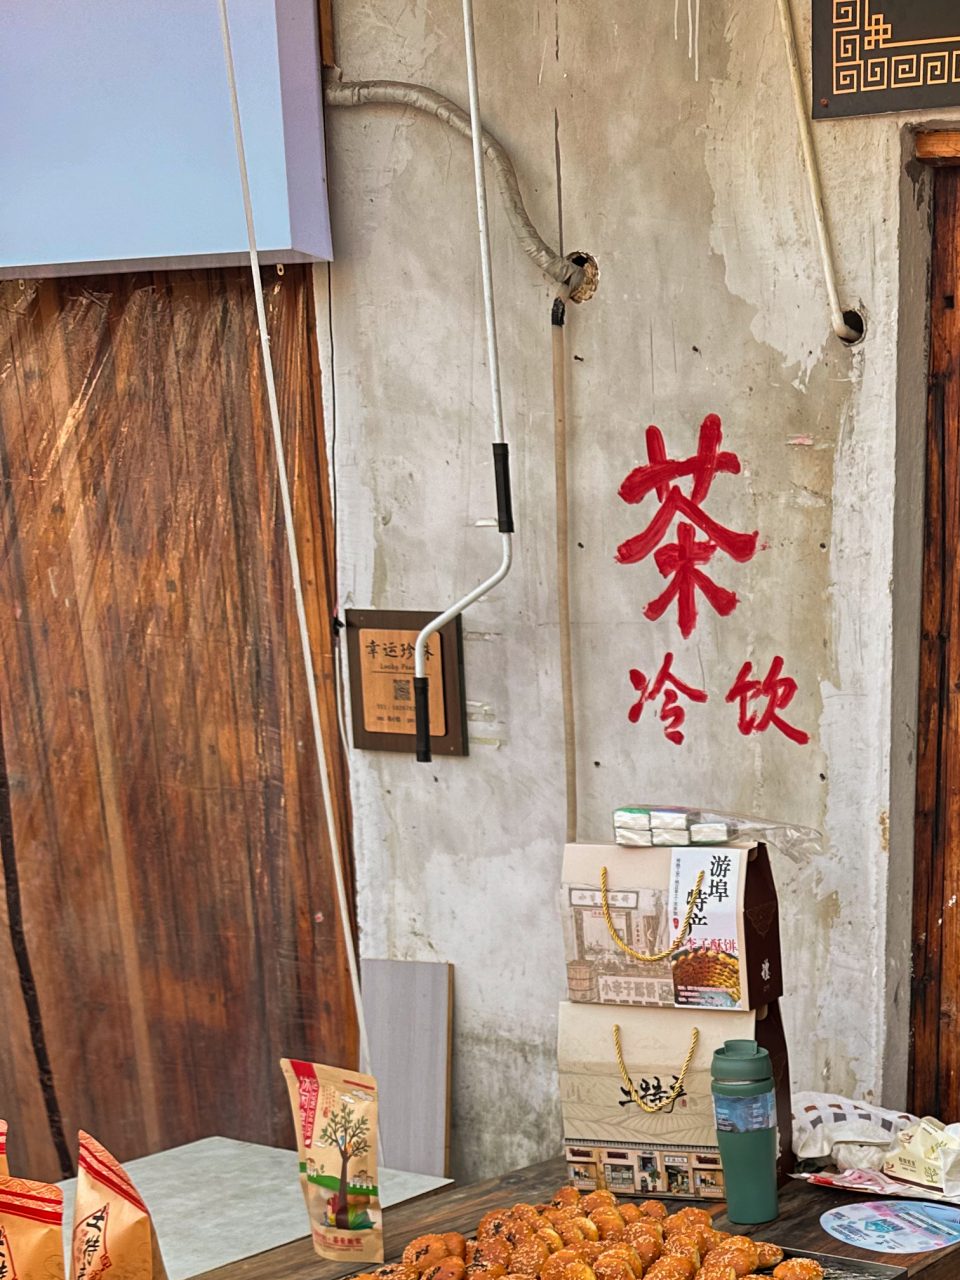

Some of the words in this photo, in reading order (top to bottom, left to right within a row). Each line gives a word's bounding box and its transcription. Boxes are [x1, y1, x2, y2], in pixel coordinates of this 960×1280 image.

[614, 413, 759, 640] 茶
[626, 652, 810, 746] 冷饮
[687, 889, 708, 936] 特产
[708, 855, 732, 903] 游埠
